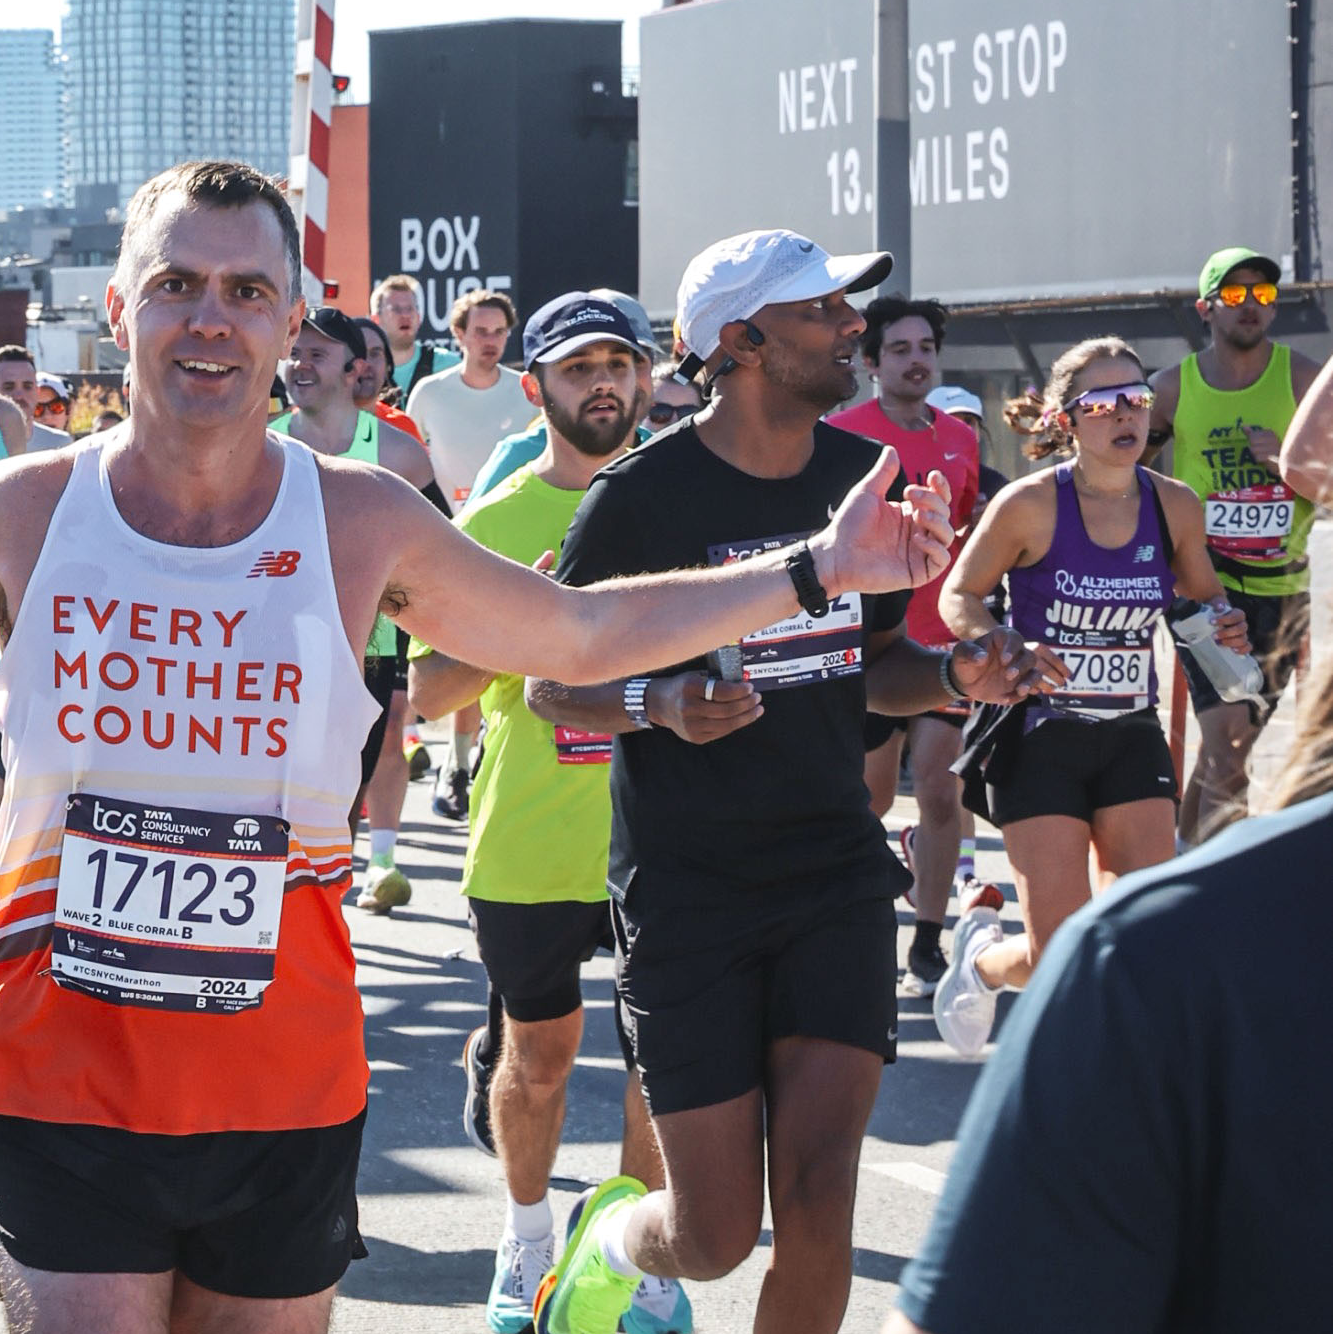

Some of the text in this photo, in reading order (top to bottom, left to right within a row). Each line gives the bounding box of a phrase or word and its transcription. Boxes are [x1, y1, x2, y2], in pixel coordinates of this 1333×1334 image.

[778, 58, 857, 134] NEXT
[973, 19, 1068, 105] STOP
[909, 127, 1010, 207] MILES
[400, 215, 481, 272] BOX
[1202, 446, 1258, 469] TEA
[1212, 503, 1290, 529] 24979
[1080, 575, 1160, 589] ALZHEIMER'S
[1074, 588, 1163, 601] ASSOCIATION
[53, 595, 248, 648] EVERY
[805, 619, 813, 630] C
[1059, 629, 1083, 646] tcs
[54, 649, 303, 704] MOTHER
[57, 704, 288, 758] COUNTS
[93, 800, 137, 837] tcs
[143, 809, 173, 822] TATA
[140, 830, 185, 845] SERVICES
[141, 821, 211, 838] CONSULTANCY
[227, 839, 262, 852] TATA
[87, 848, 257, 926] 17123
[62, 908, 193, 940] WAVE 2 BLUE CORRAL B
[73, 965, 162, 987] #TCSNYCMarathon
[199, 979, 247, 996] 2024
[195, 996, 207, 1008] B
